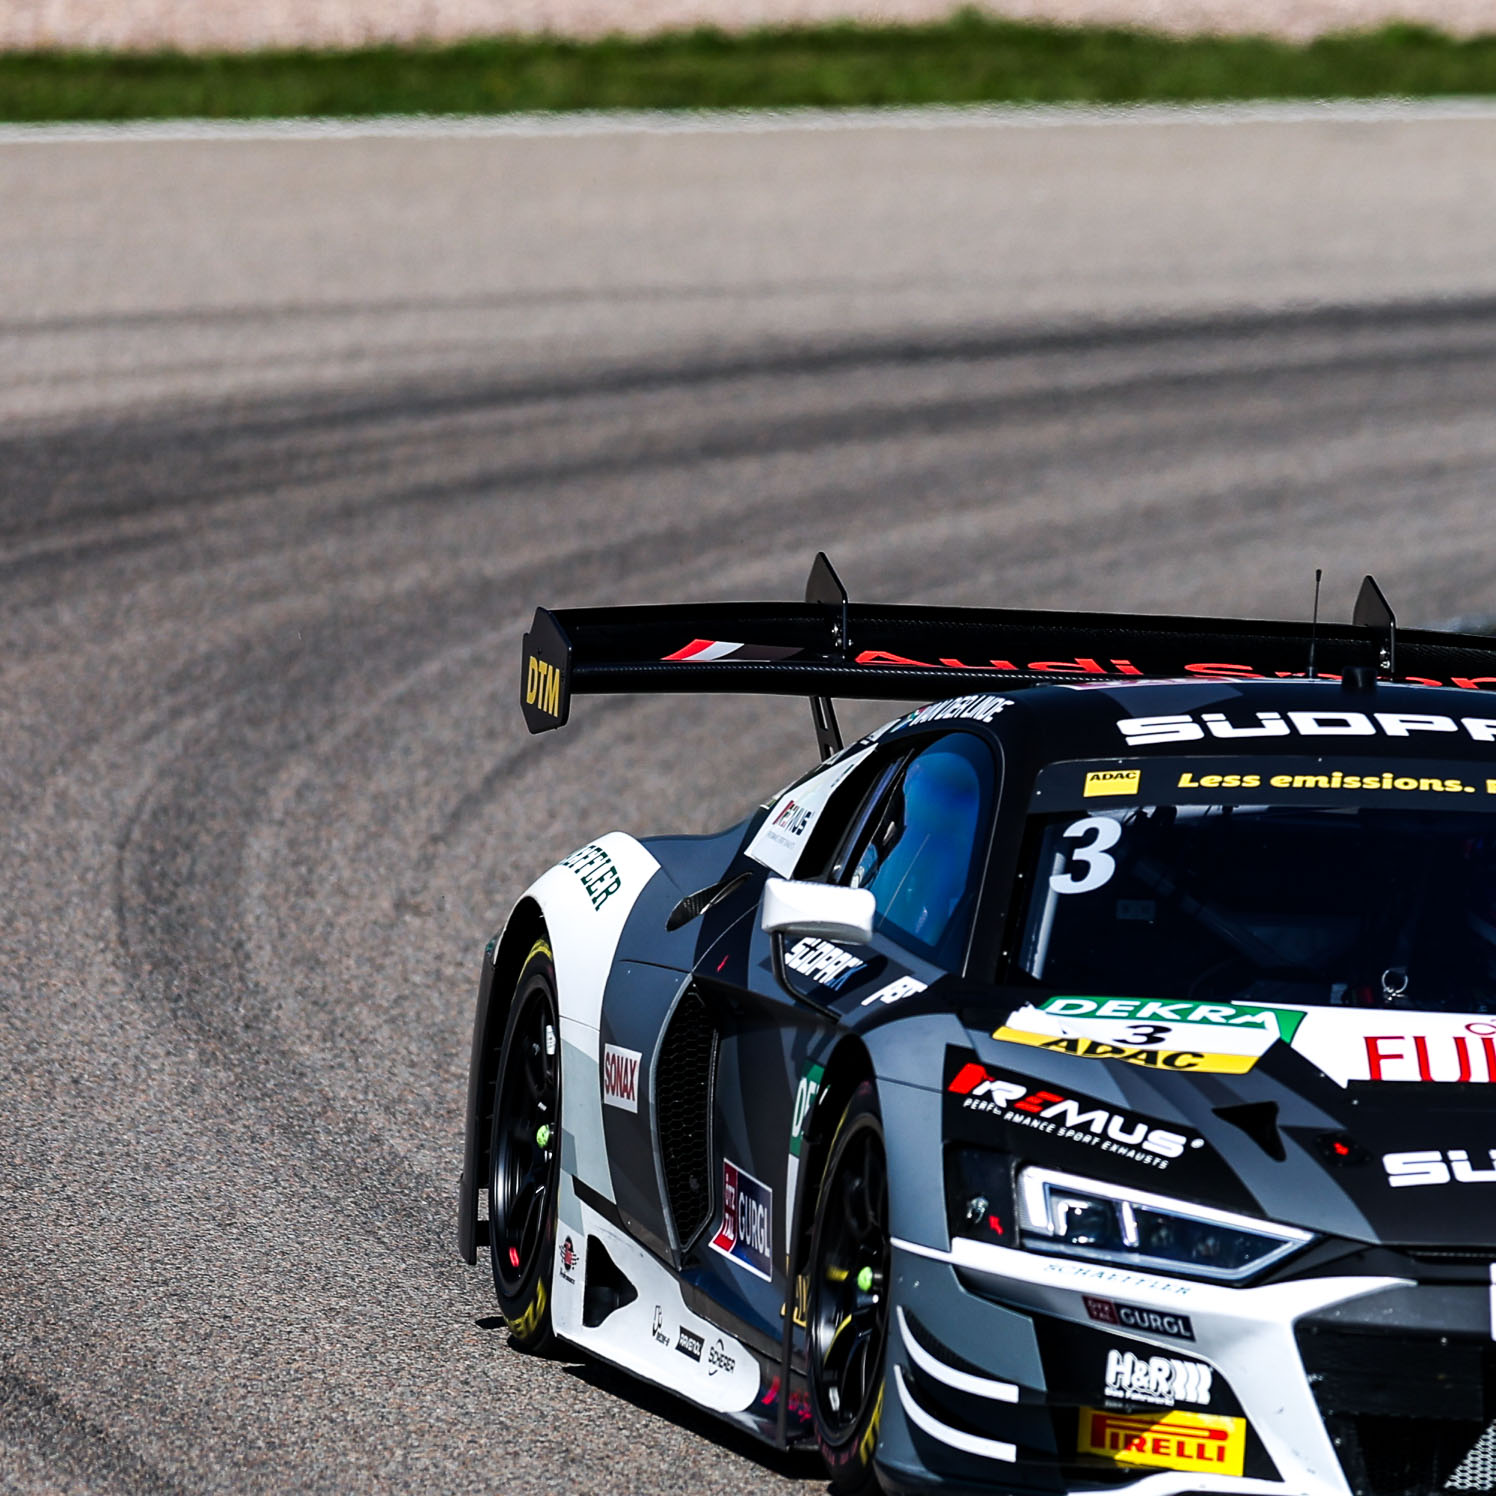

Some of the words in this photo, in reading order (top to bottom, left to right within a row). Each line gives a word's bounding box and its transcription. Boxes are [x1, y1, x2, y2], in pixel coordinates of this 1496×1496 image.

[854, 650, 1144, 676] Audi
[526, 655, 560, 717] DTM
[1089, 771, 1137, 782] ADAC
[1177, 773, 1261, 788] Less
[1269, 772, 1476, 794] emissions.
[1049, 816, 1122, 894] 3
[1045, 998, 1281, 1035] DEKRA
[1113, 1024, 1172, 1045] 3
[1038, 1038, 1205, 1070] ADAC
[605, 1052, 637, 1101] SONAX
[972, 1079, 1188, 1158] REMUS
[1056, 1126, 1100, 1146] SPORT
[1101, 1140, 1170, 1170] EXHAUSTS
[738, 1190, 771, 1257] GURGL
[1119, 1307, 1192, 1338] GURGL
[1105, 1349, 1180, 1398] H&R
[1090, 1413, 1229, 1464] PIRELLI
